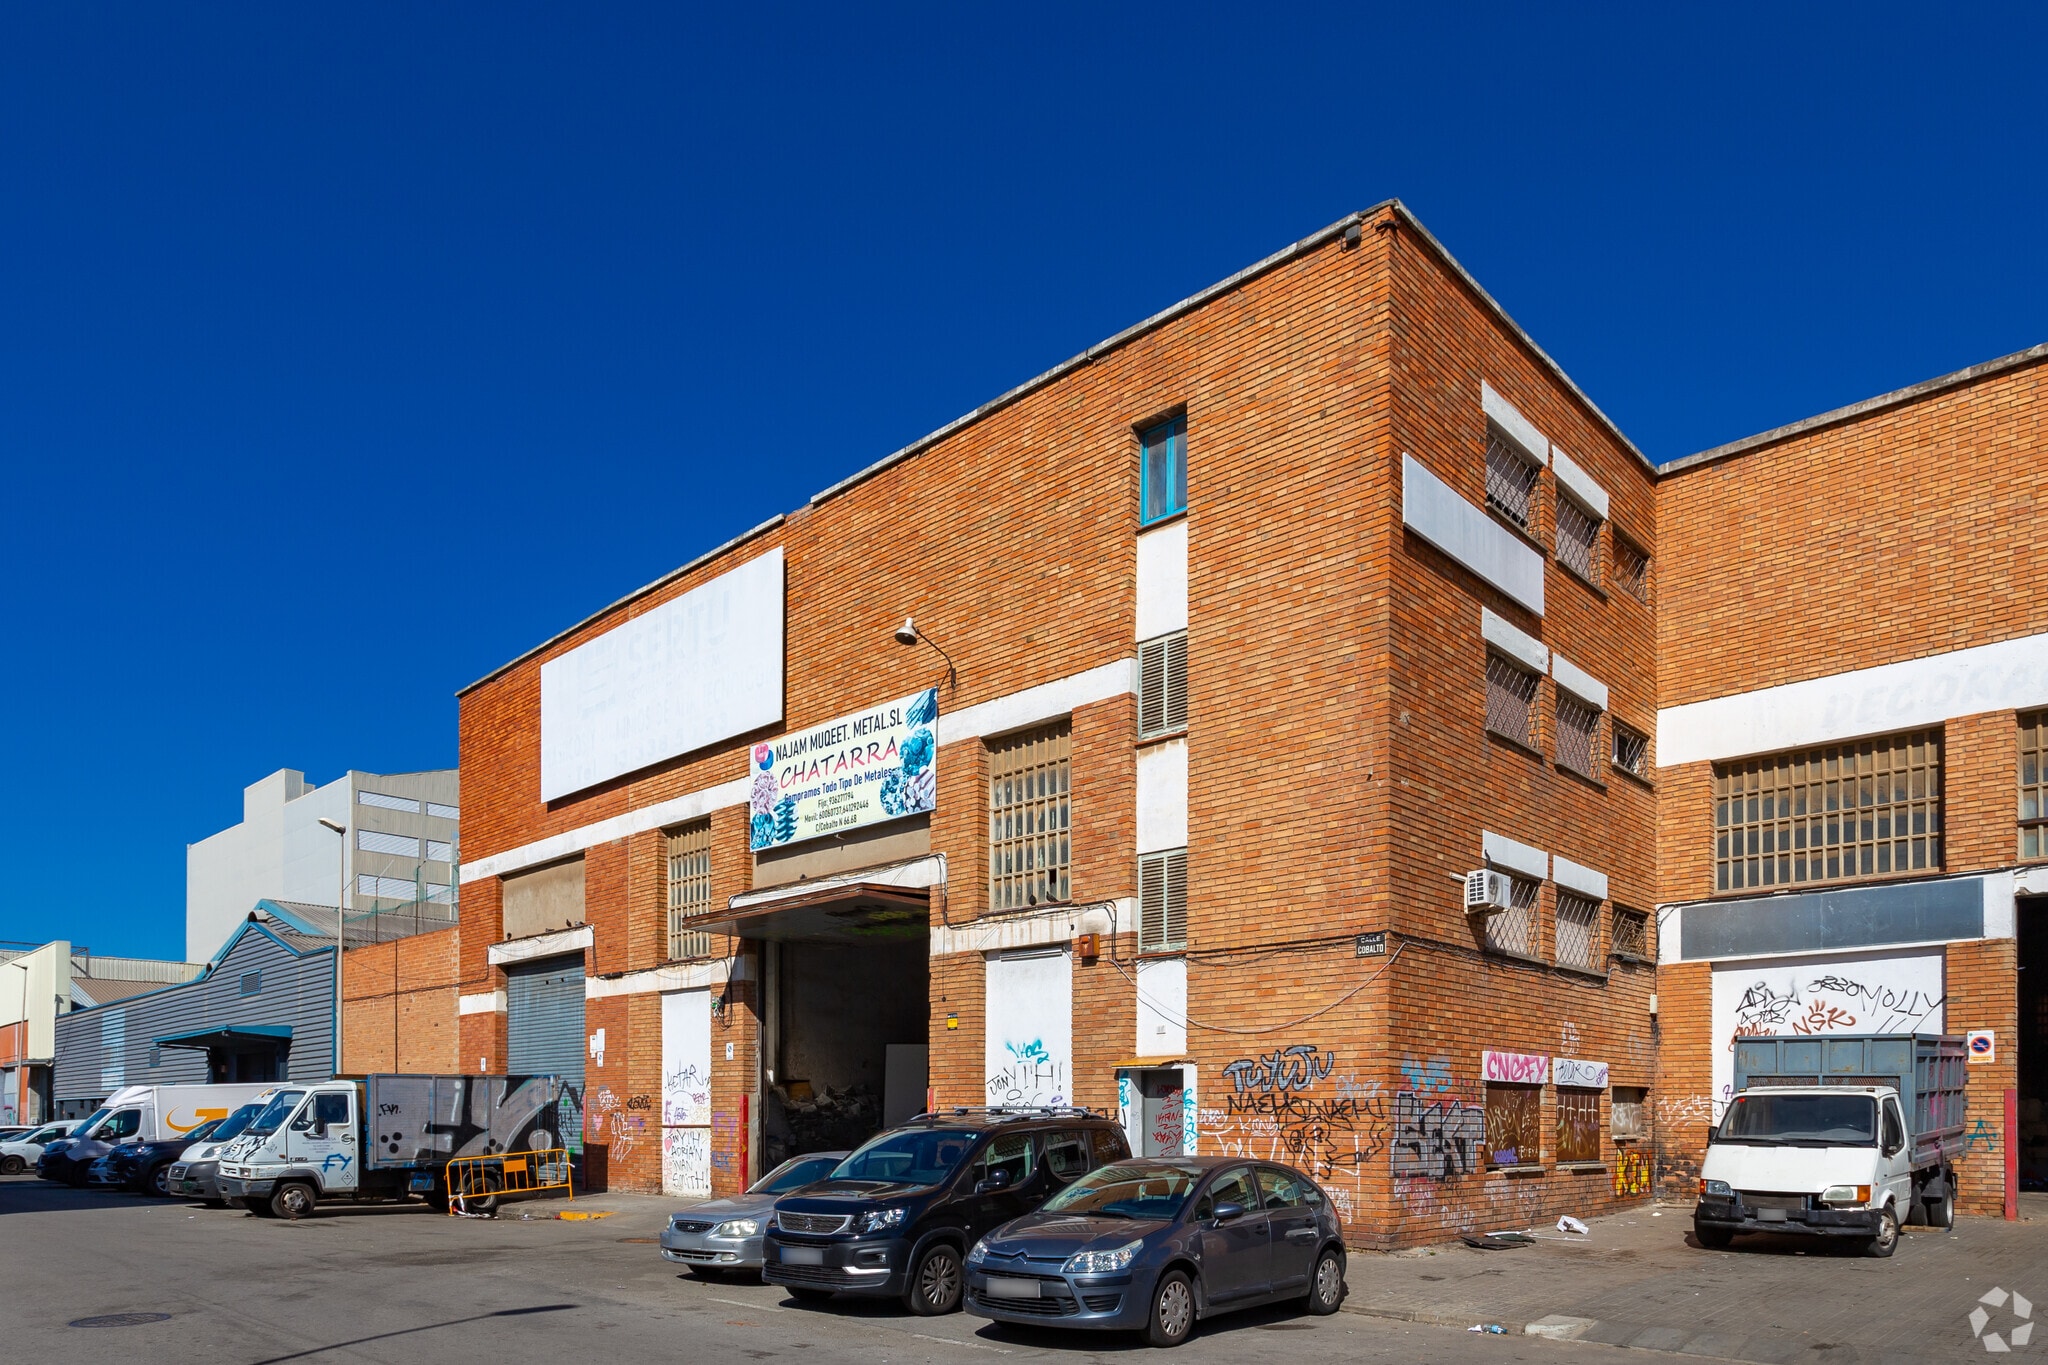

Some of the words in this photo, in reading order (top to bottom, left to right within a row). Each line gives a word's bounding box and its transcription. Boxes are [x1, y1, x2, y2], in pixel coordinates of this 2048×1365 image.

[776, 737, 807, 762] NAJAM
[810, 724, 850, 752] MUQEET.
[853, 708, 902, 737] METAL.SL
[780, 736, 899, 789] CHATARRA
[784, 786, 821, 804] Compramos
[822, 781, 838, 795] Todo
[839, 776, 853, 791] Tipo
[854, 774, 863, 785] De
[1357, 943, 1384, 955] COBALTO
[1361, 935, 1381, 944] CALLE
